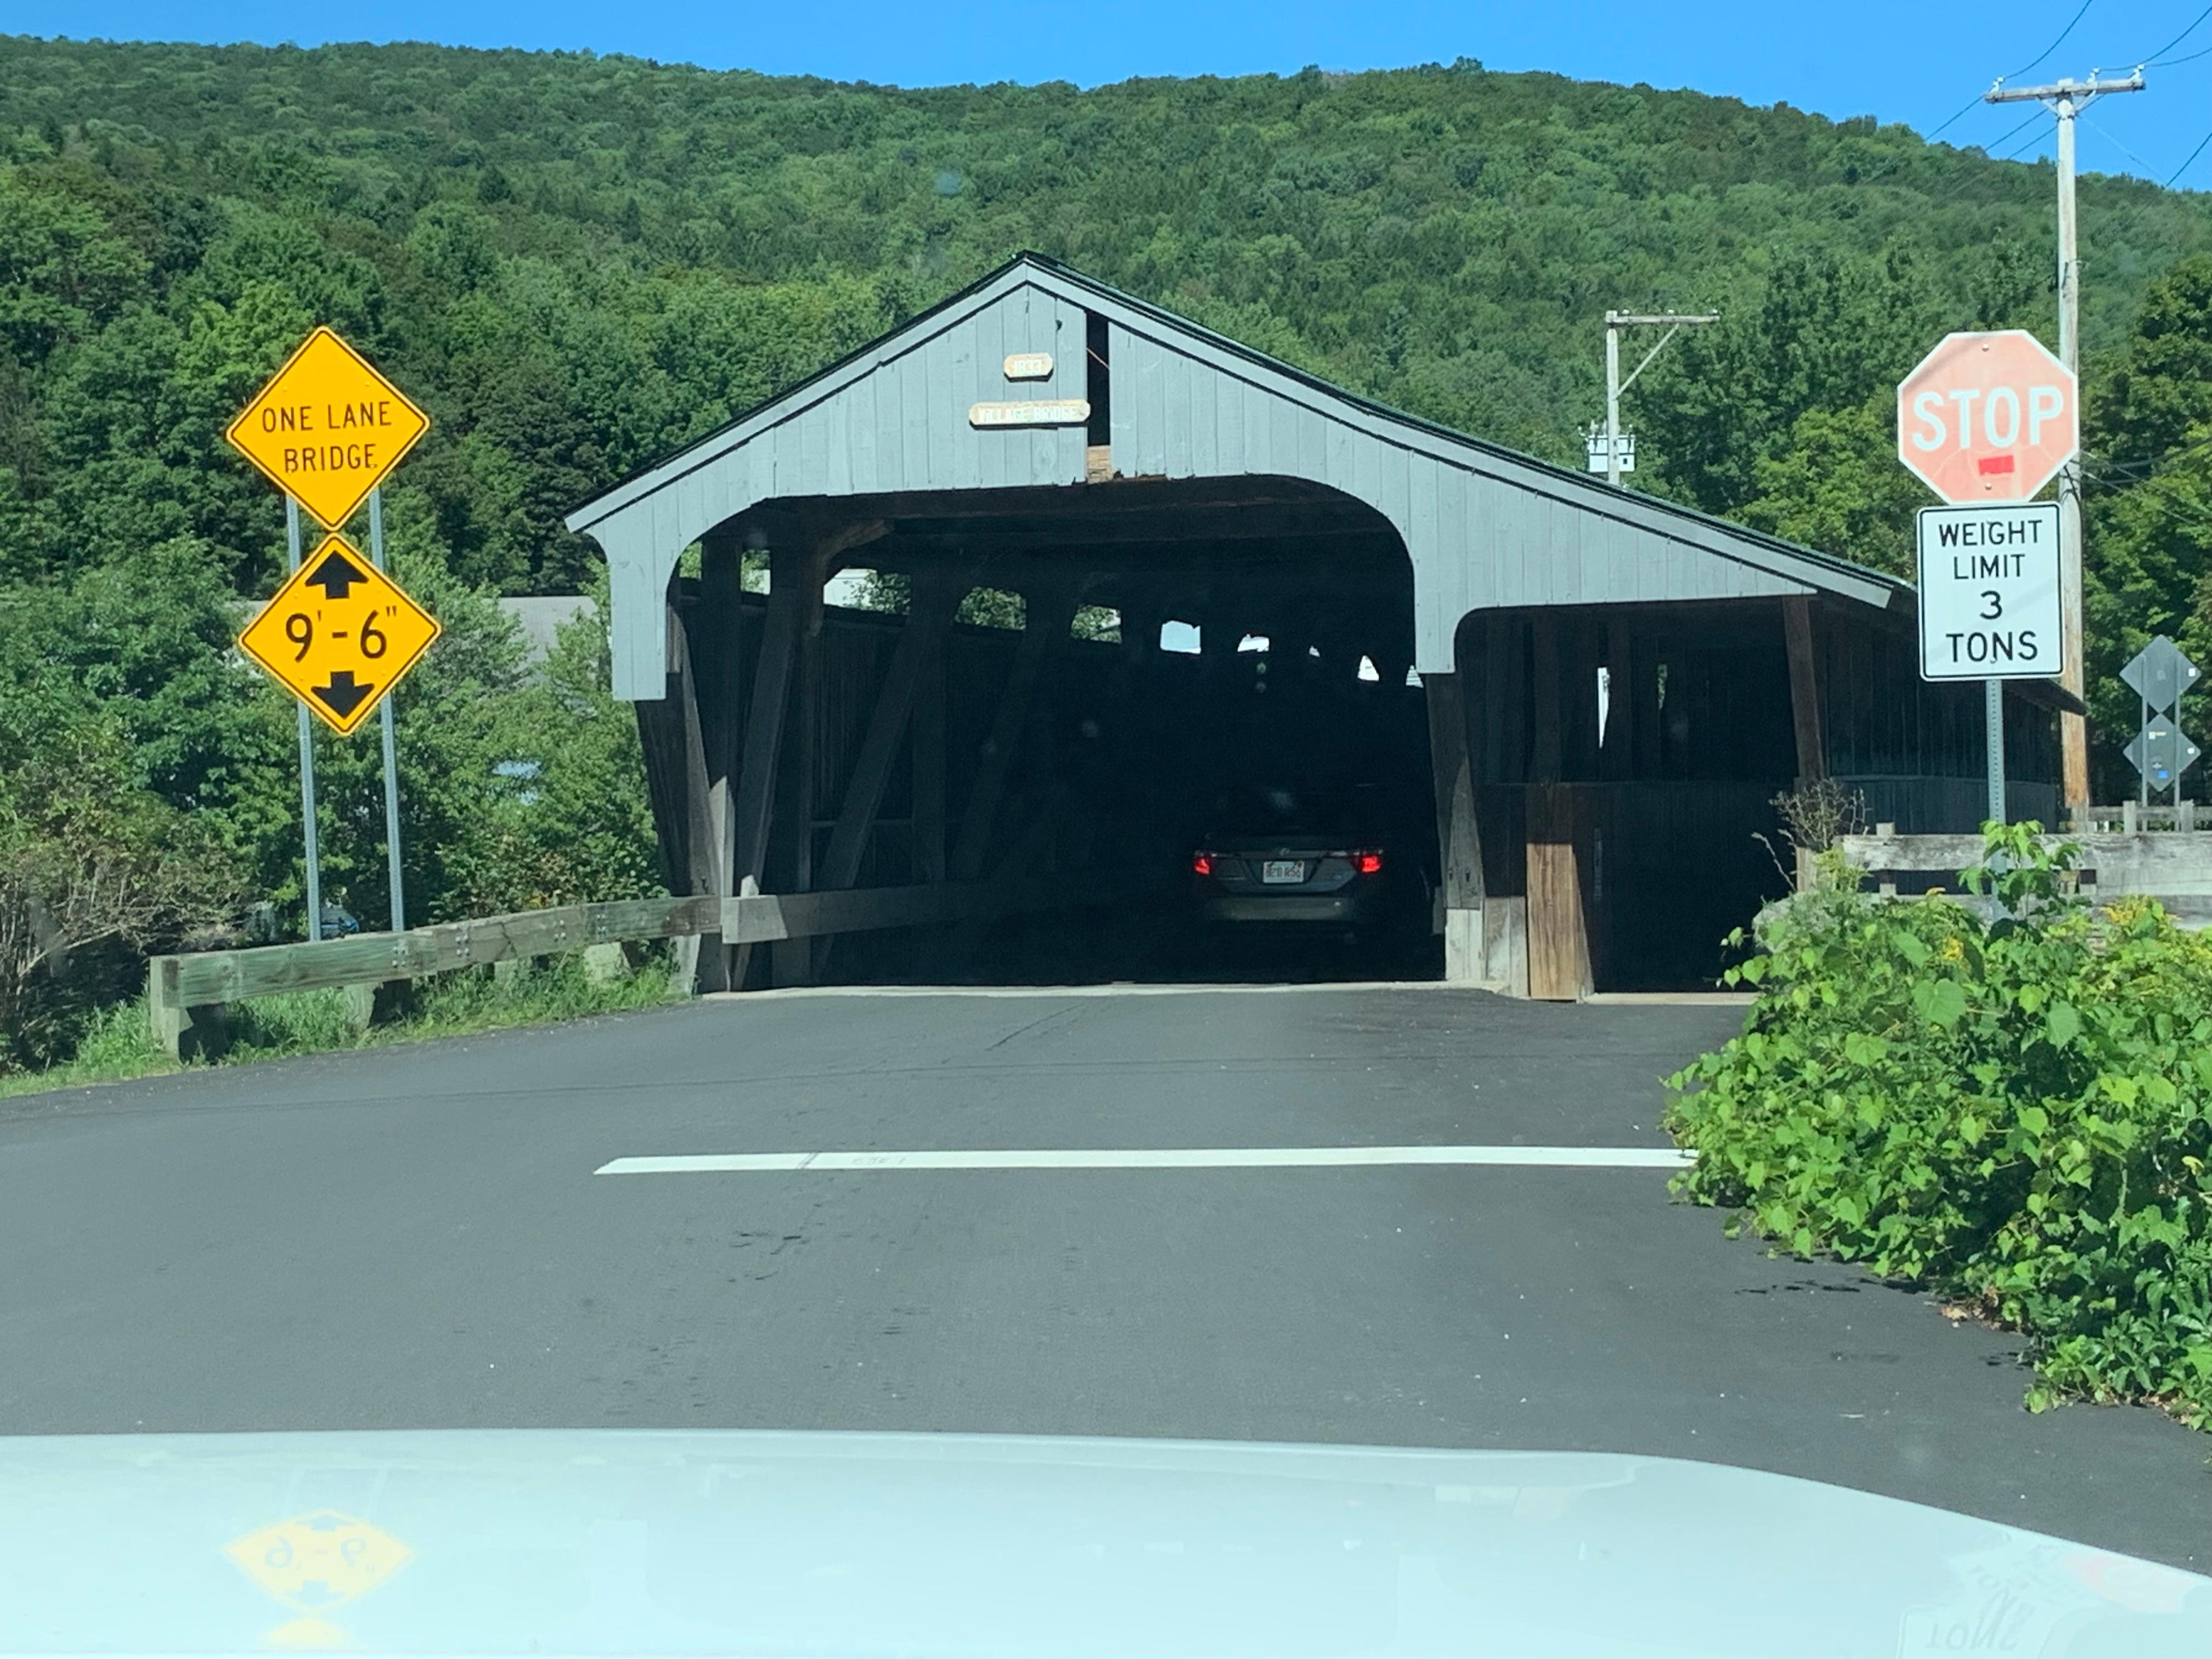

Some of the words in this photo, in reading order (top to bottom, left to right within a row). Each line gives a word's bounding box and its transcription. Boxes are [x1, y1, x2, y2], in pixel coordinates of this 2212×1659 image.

[262, 406, 313, 433] ONE
[328, 401, 393, 430] LANE
[977, 407, 1029, 422] VILLAGE
[1034, 405, 1079, 421] BRIDGE
[1912, 385, 2064, 452] STOP
[284, 443, 377, 472] BRIDGE
[1939, 520, 2043, 547] WEIGHT
[1953, 554, 2025, 580] LIMIT
[1979, 590, 2003, 620] 3
[1946, 630, 2038, 663] TONS
